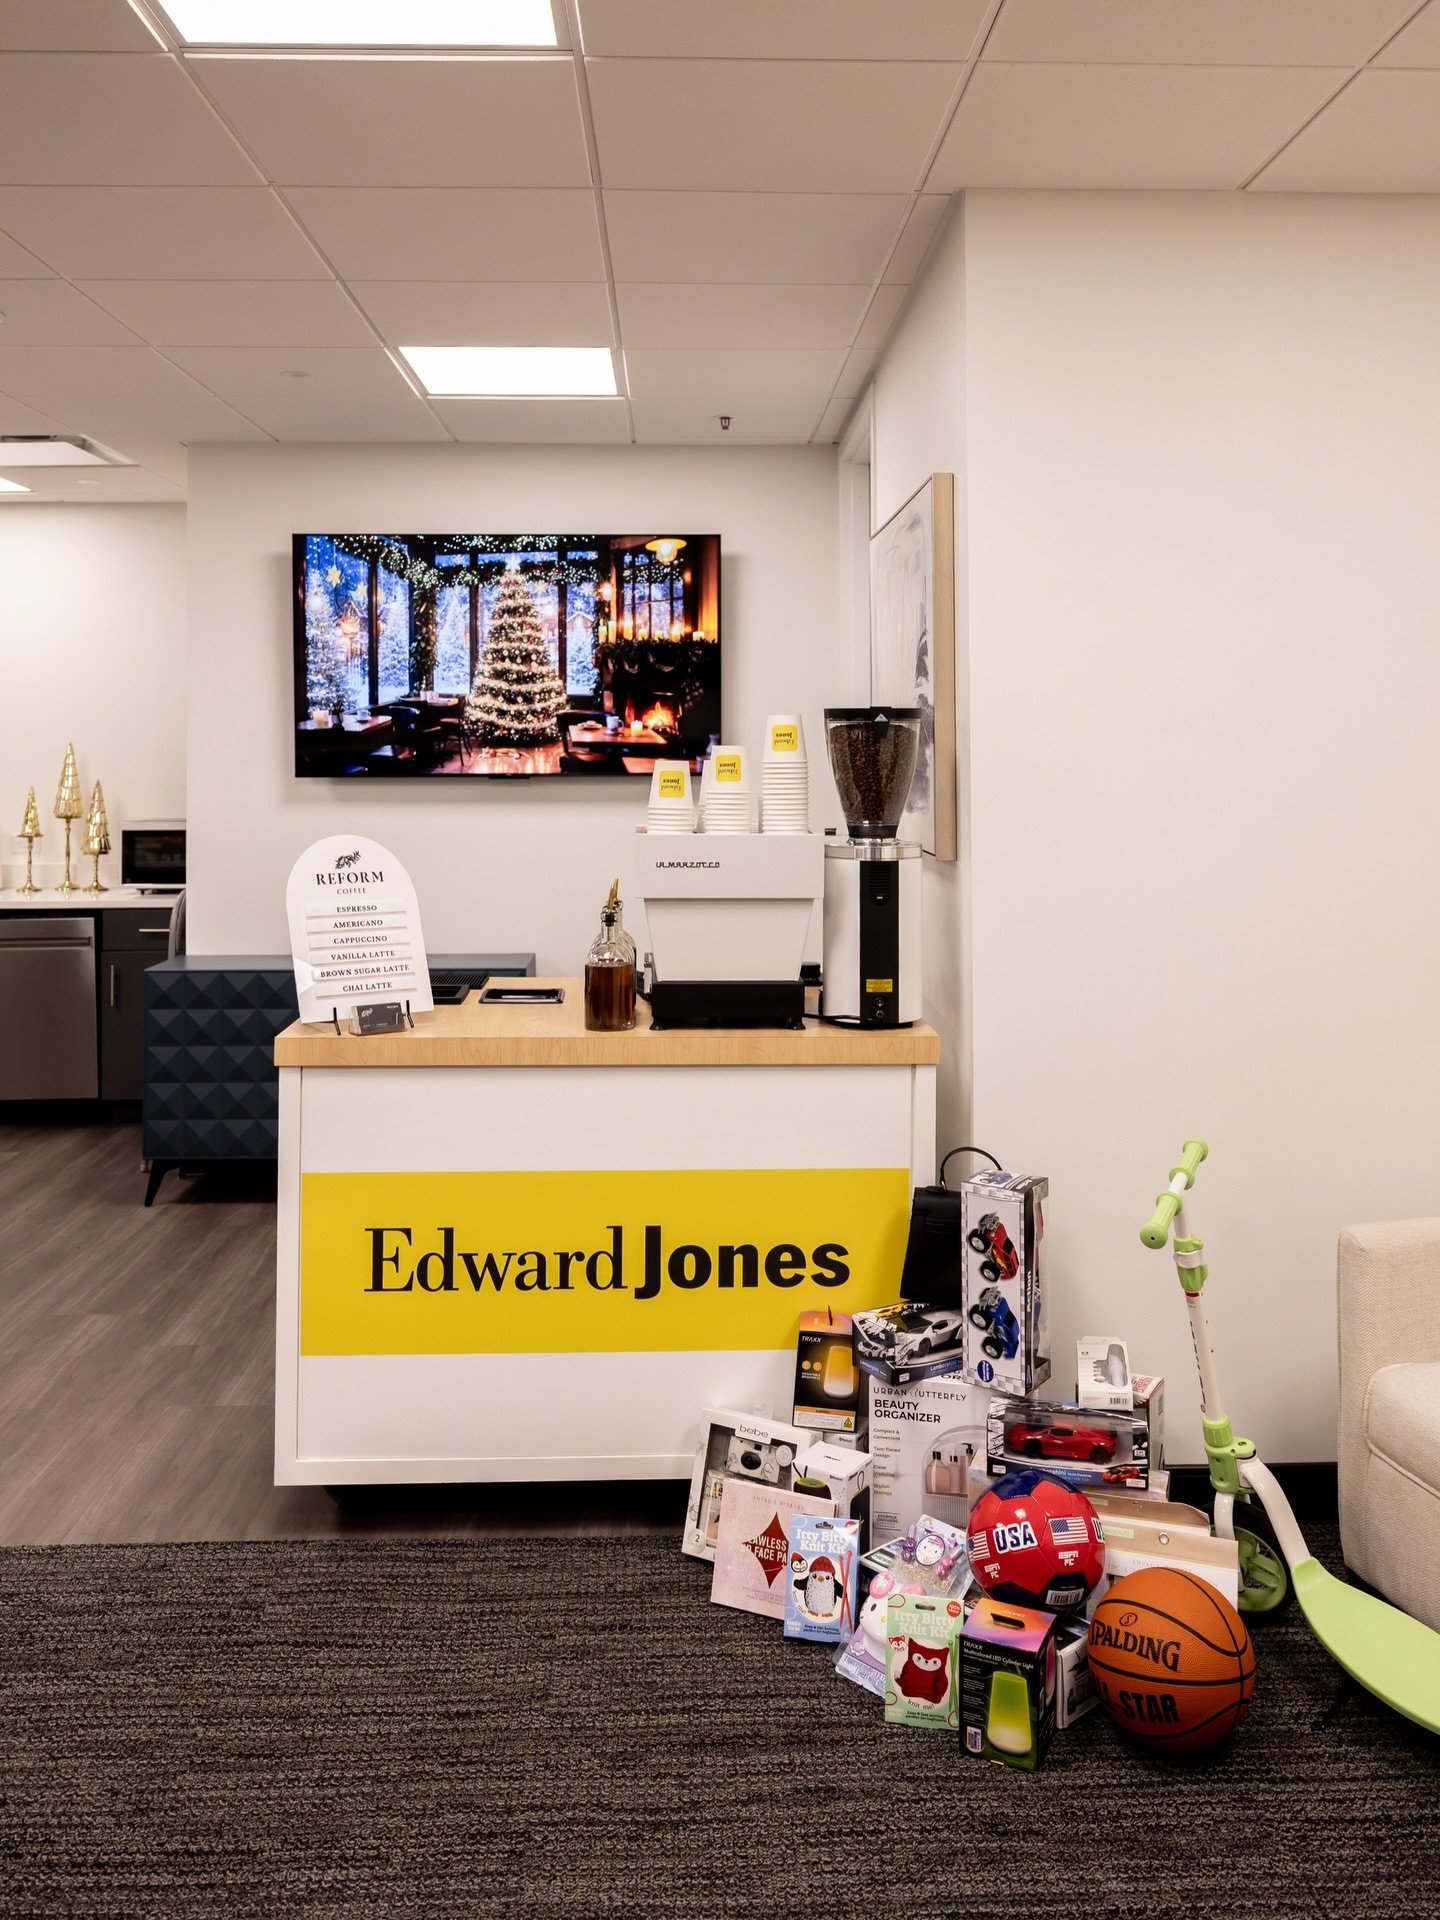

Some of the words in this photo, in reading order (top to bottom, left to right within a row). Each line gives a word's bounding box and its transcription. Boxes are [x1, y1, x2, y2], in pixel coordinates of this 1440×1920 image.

[316, 871, 384, 885] REFORM
[336, 887, 367, 895] COFFEE
[336, 904, 378, 913] ESPRESSO
[333, 919, 383, 929] AMERICANO
[333, 935, 388, 945] CAPPUCCINO
[331, 952, 367, 961] VANILLA
[369, 950, 396, 958] LATTE
[320, 968, 352, 978] BROWN
[354, 966, 382, 975] SUGAR
[383, 964, 410, 973] LATTE
[342, 984, 363, 992] CHAI
[365, 981, 393, 990] LATTE
[801, 1335, 822, 1343] TRAXX
[873, 1387, 907, 1396] URBAN
[874, 1399, 919, 1411] BEAUTY
[874, 1410, 941, 1423] ORGANIZER
[740, 1425, 769, 1438] bebe
[695, 1534, 700, 1543] 2
[993, 1521, 1038, 1553] USA
[754, 1545, 775, 1561] FACE
[800, 1540, 826, 1552] Knit
[827, 1543, 847, 1555] Kit
[1058, 1550, 1079, 1560] ESPN
[984, 1563, 1001, 1573] ESPN
[1063, 1559, 1075, 1567] FC
[990, 1571, 1000, 1579] FC
[900, 1622, 928, 1636] Knit
[929, 1626, 950, 1639] Kit
[963, 1640, 984, 1650] TRAXX
[1088, 1619, 1182, 1672] SPALDING
[992, 1654, 1002, 1662] LED
[1002, 1657, 1022, 1667] Cylinder
[1022, 1662, 1034, 1671] Light
[907, 1698, 920, 1709] knit
[1119, 1690, 1180, 1723] STAR
